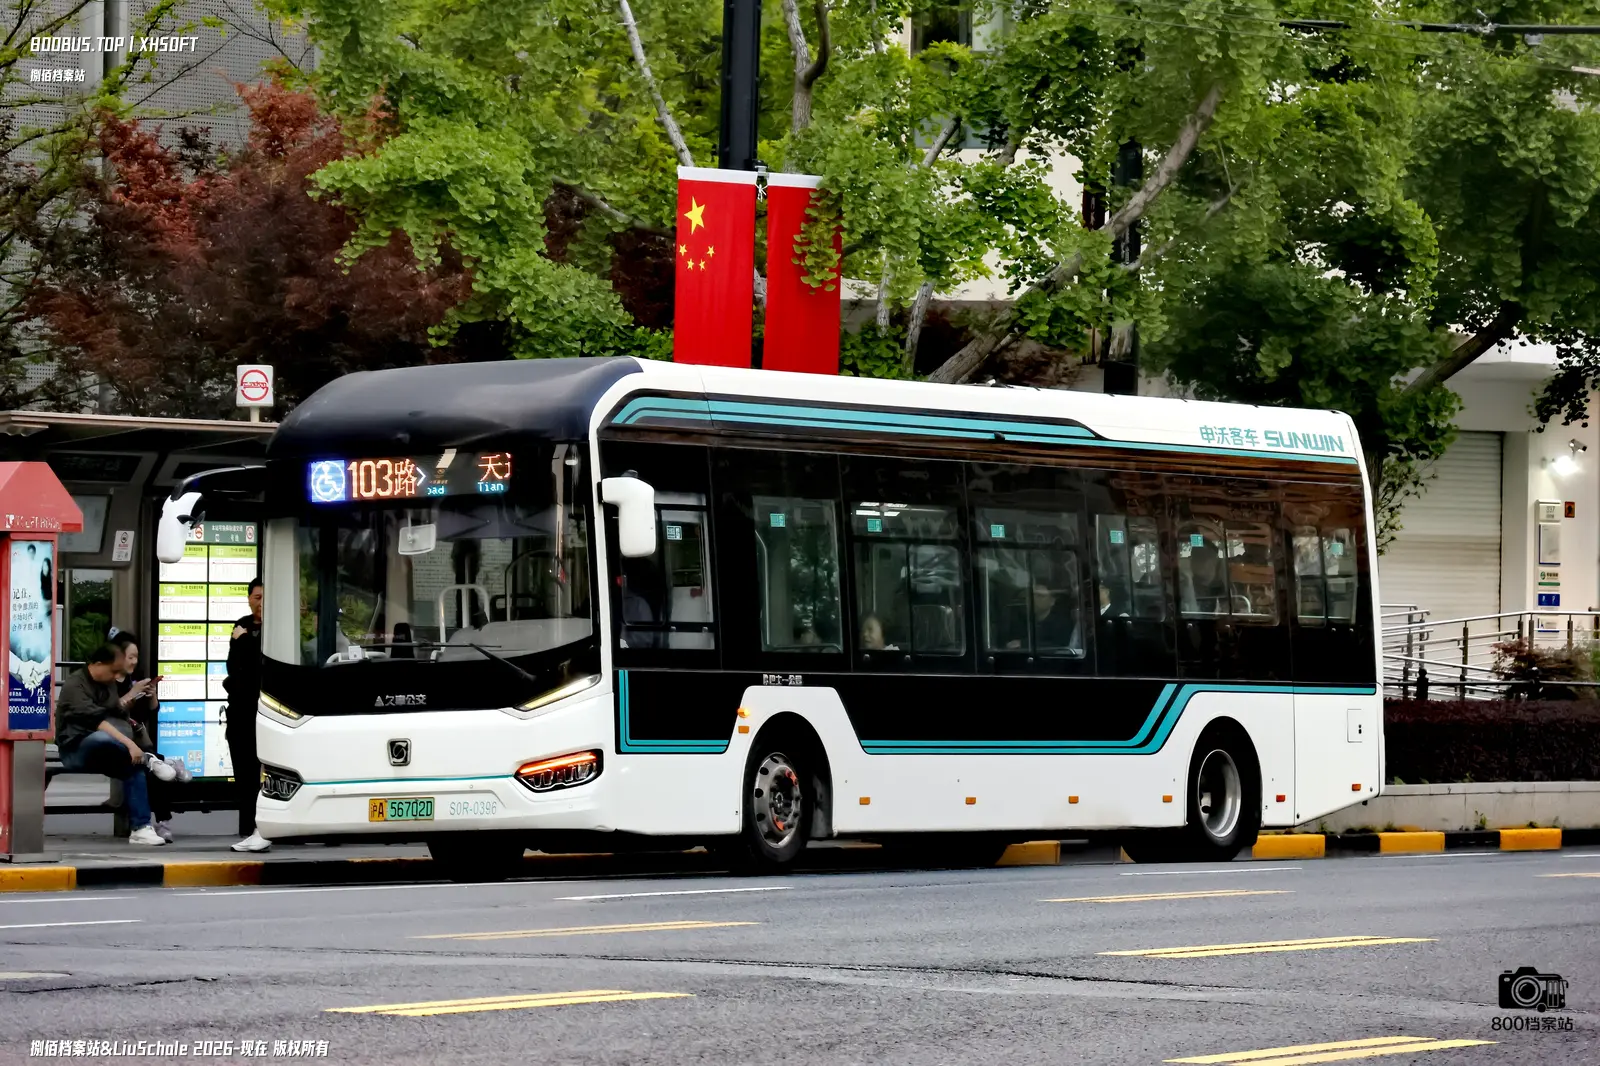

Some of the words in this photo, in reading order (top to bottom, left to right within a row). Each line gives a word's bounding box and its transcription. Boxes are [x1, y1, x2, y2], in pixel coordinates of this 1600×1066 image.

[1199, 425, 1260, 447] 申沃客车
[1264, 430, 1345, 453] SUNWIN
[347, 458, 417, 498] 103路
[477, 481, 504, 492] Tian
[8, 705, 47, 714] 800-8200-666
[390, 800, 433, 818] 56702D
